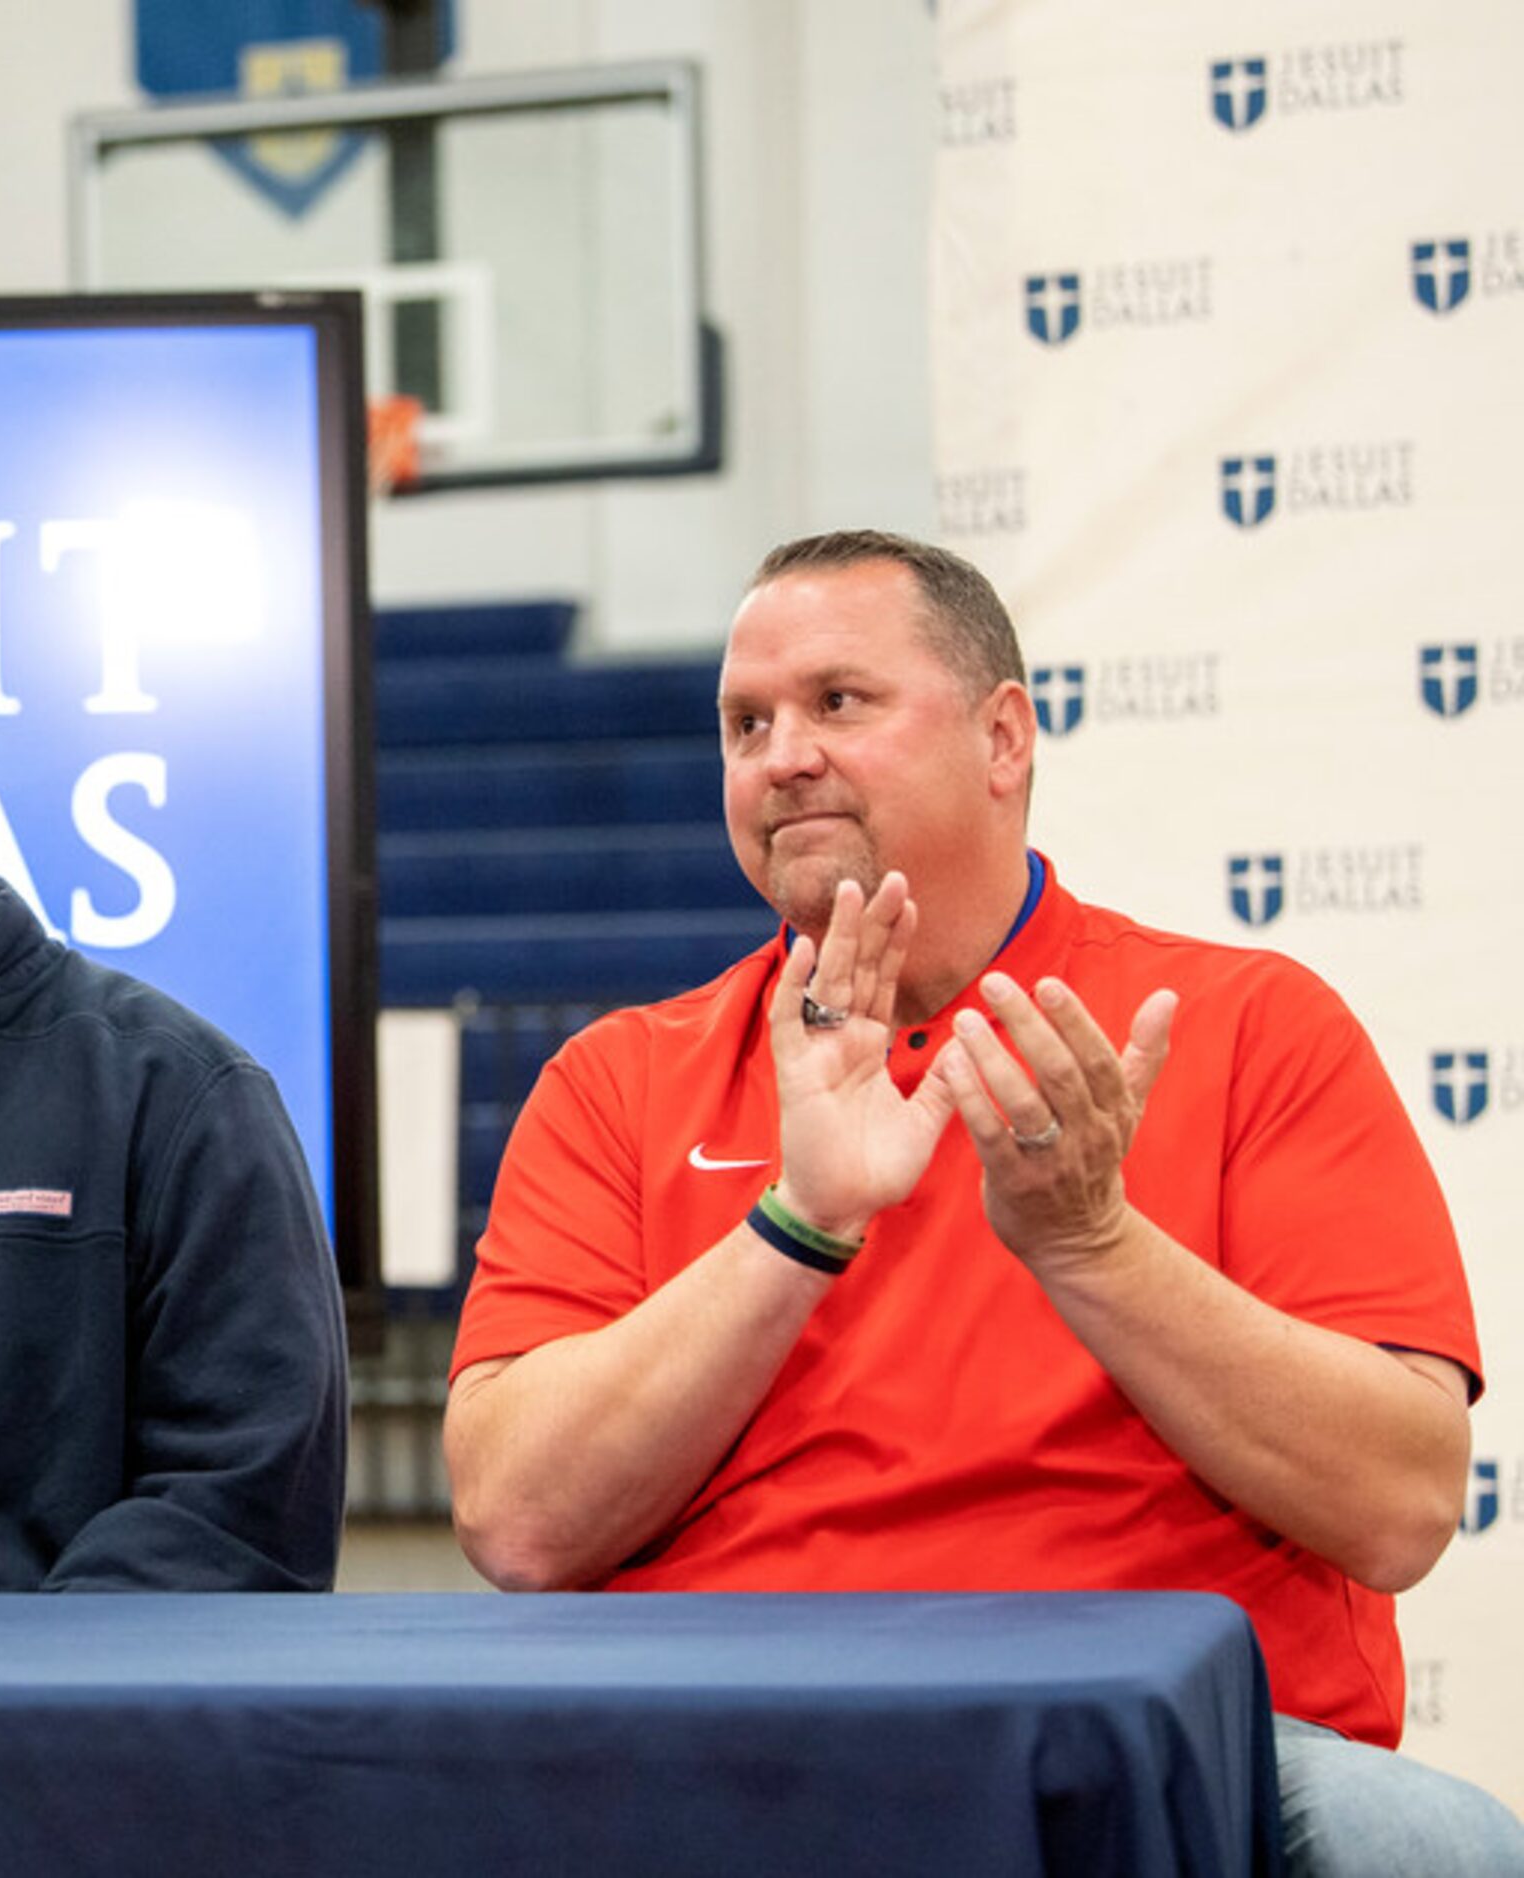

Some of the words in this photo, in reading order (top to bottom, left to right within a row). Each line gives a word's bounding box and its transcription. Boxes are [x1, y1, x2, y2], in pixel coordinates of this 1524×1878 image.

[1279, 38, 1404, 78] JESUIT
[1277, 74, 1404, 115] DALLAS
[1093, 256, 1213, 294] JESUIT
[1089, 288, 1213, 329] DALLAS
[1290, 441, 1414, 479] JESUIT
[1287, 475, 1414, 514] DALLAS
[1098, 654, 1220, 691] JESUIT
[1095, 686, 1220, 724] DALLAS
[1295, 876, 1423, 914] DALLAS
